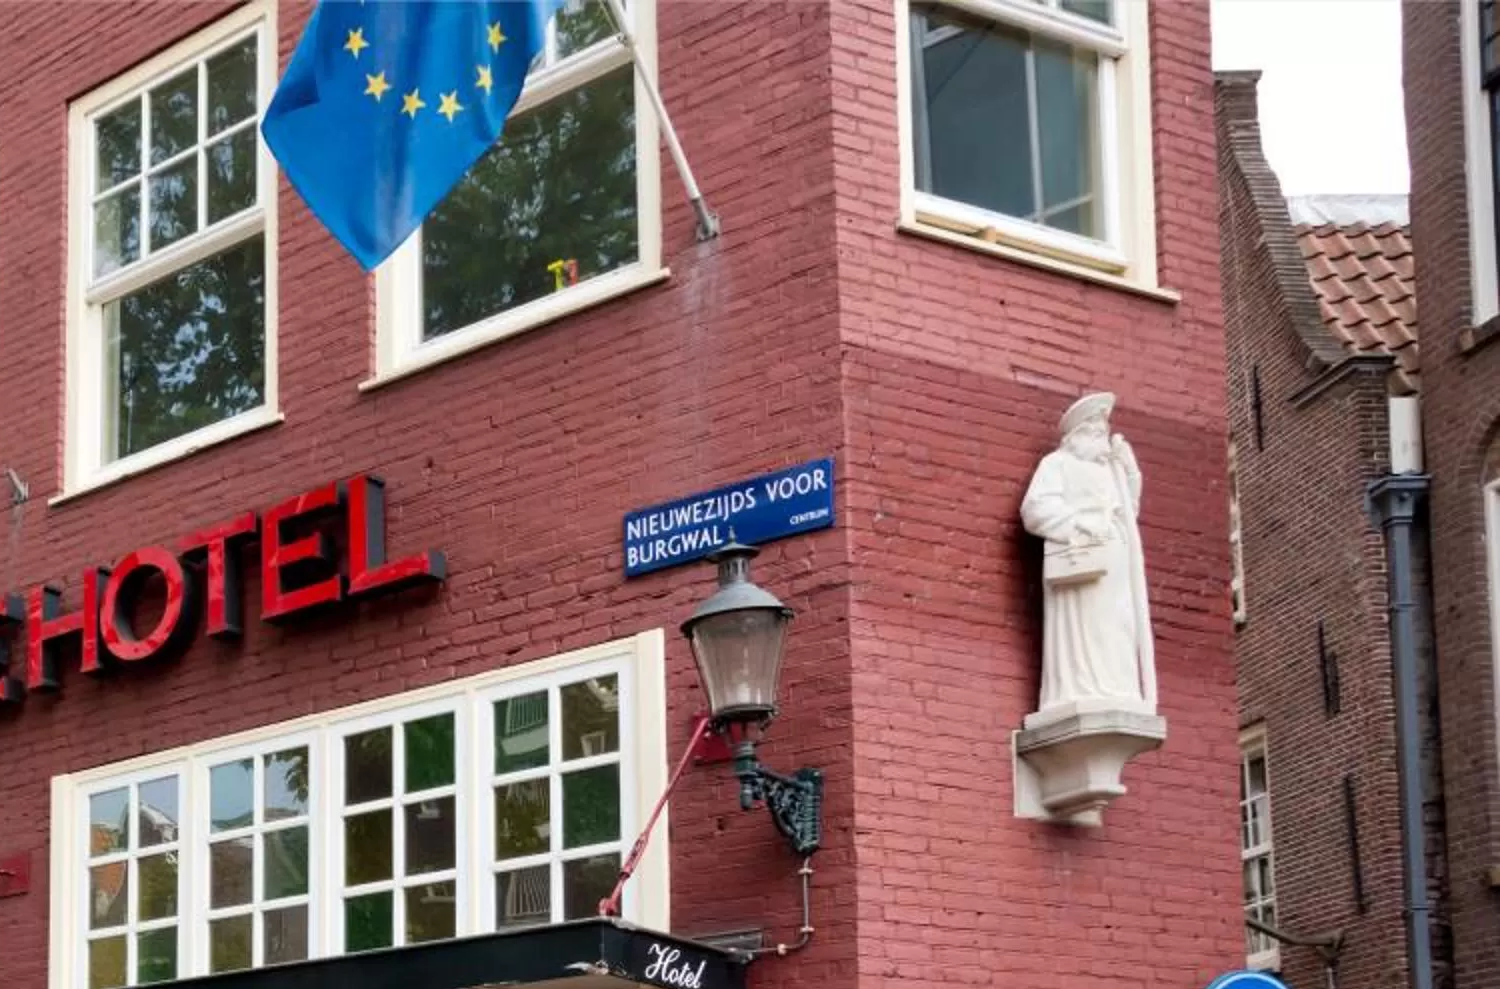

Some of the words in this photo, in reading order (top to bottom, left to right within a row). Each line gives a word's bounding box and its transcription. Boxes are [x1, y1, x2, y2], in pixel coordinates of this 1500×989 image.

[626, 487, 757, 541] NIEUWEZIJDS
[765, 468, 827, 502] VOOR
[789, 507, 829, 526] CENTRUM
[627, 525, 725, 568] BURGWAL
[27, 474, 440, 690] HOTEL
[644, 943, 708, 989] Hotel
